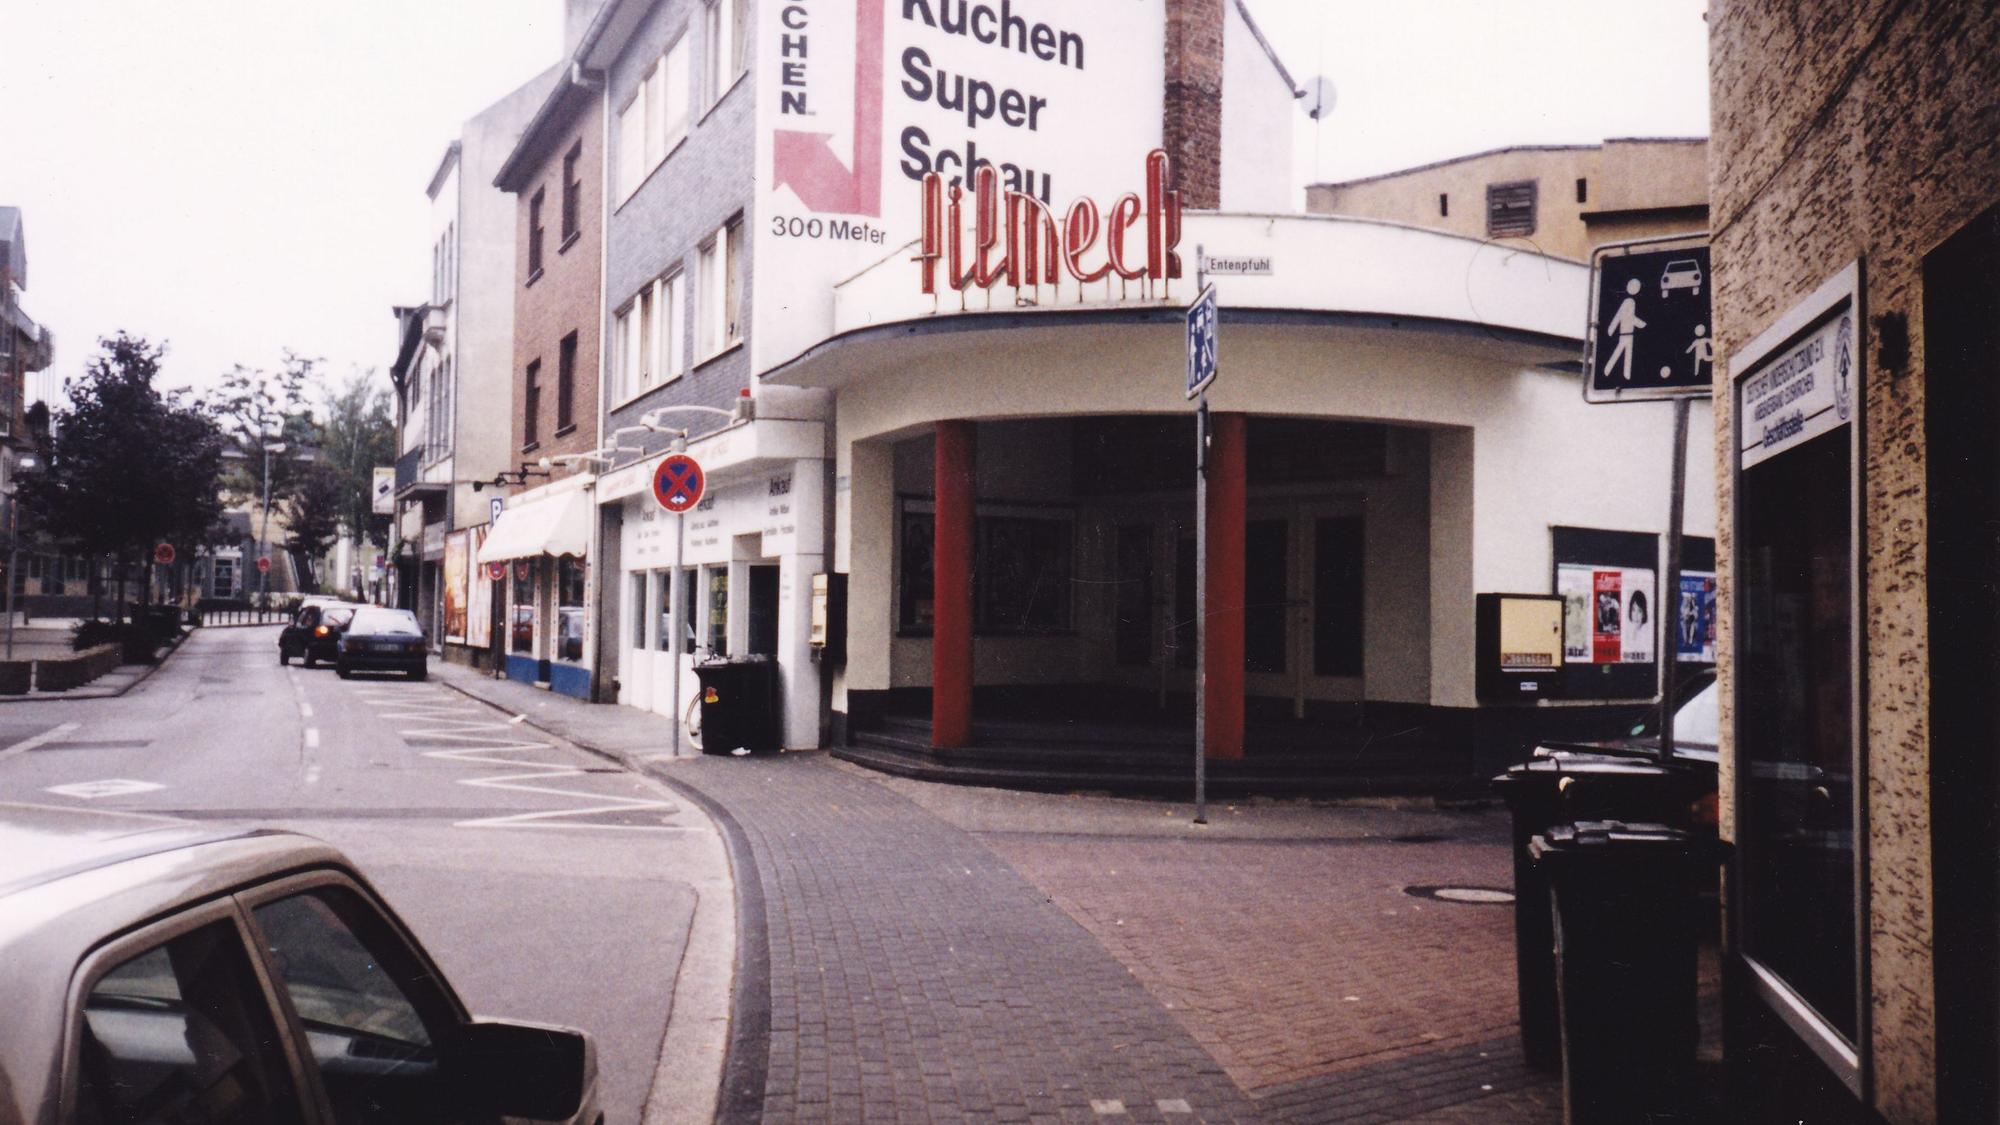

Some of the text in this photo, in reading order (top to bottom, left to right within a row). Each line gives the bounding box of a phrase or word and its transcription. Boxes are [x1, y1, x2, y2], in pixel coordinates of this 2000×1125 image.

[781, 0, 808, 115] CHEN
[901, 46, 1047, 132] Super
[772, 215, 886, 245] 300 Meter
[1210, 258, 1270, 273] Entenpfuhl
